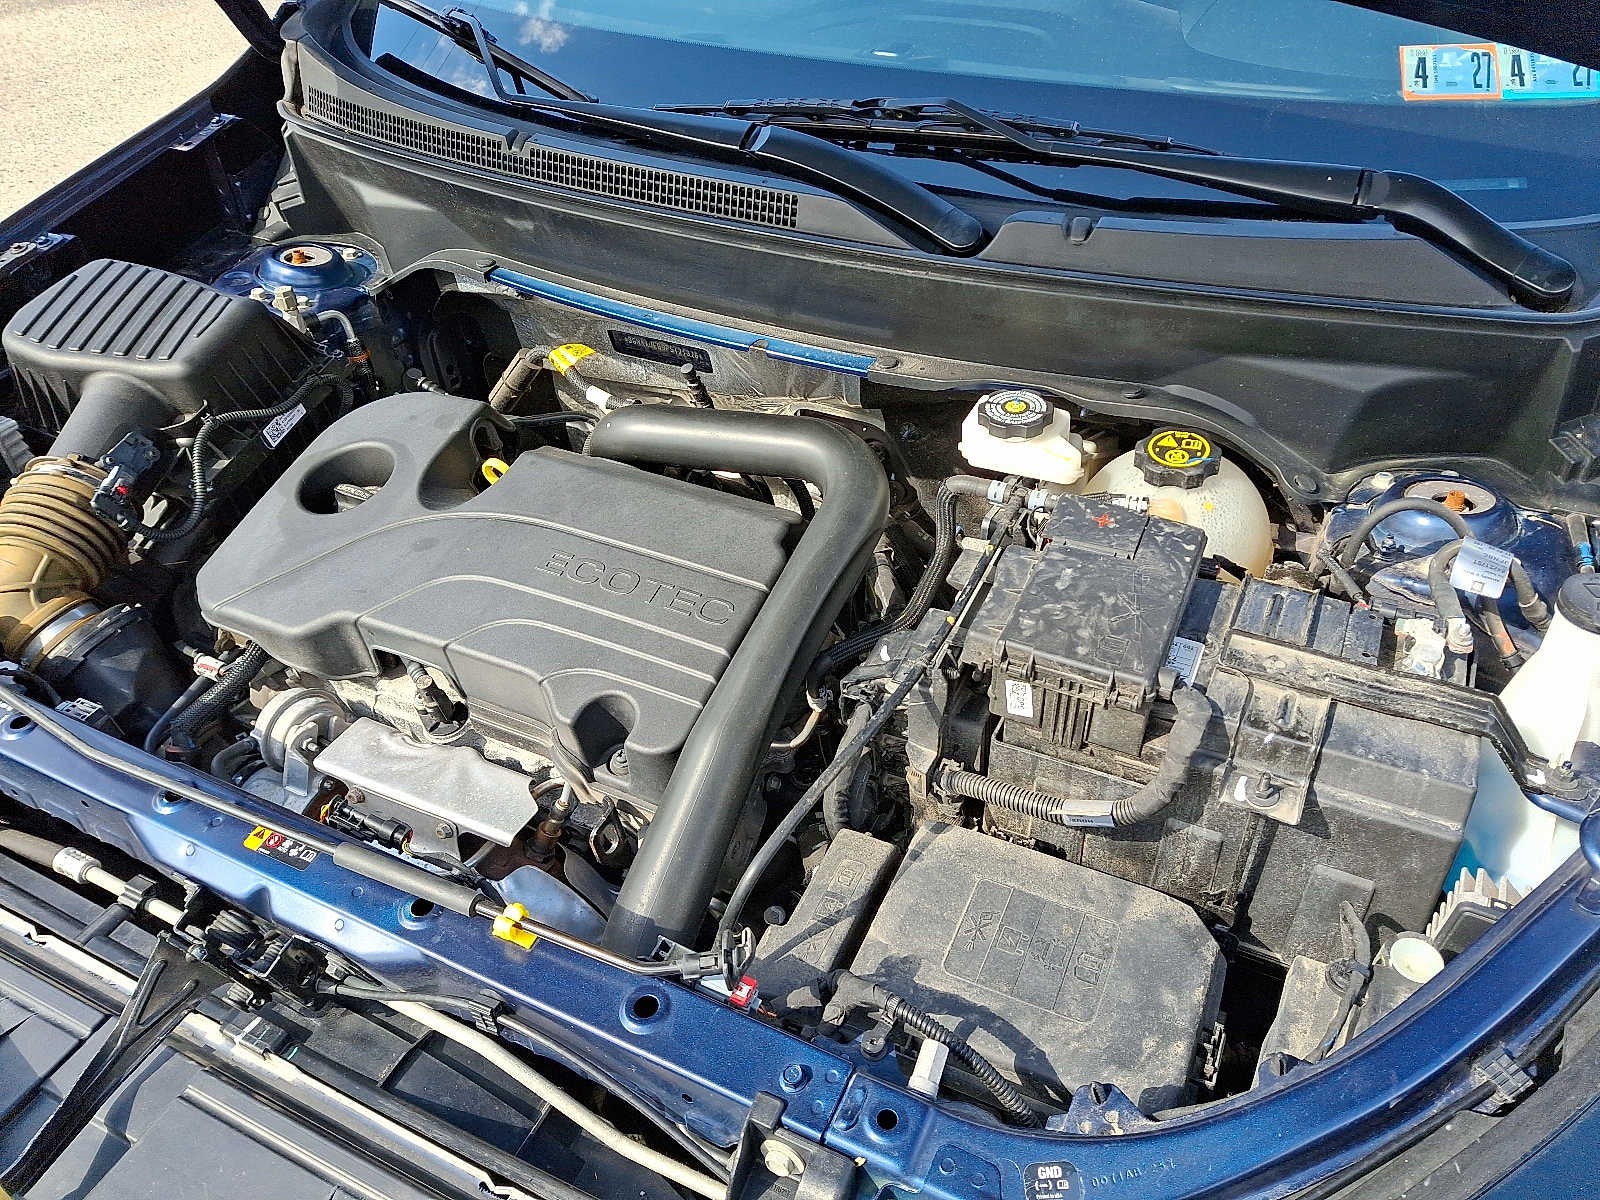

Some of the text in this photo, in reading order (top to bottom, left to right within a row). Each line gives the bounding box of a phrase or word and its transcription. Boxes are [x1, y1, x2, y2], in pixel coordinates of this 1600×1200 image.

[1414, 56, 1429, 89] 4
[1470, 52, 1491, 89] 27
[1510, 54, 1526, 87] 4
[535, 551, 735, 626] ECOTEC
[1037, 1165, 1062, 1180] GND
